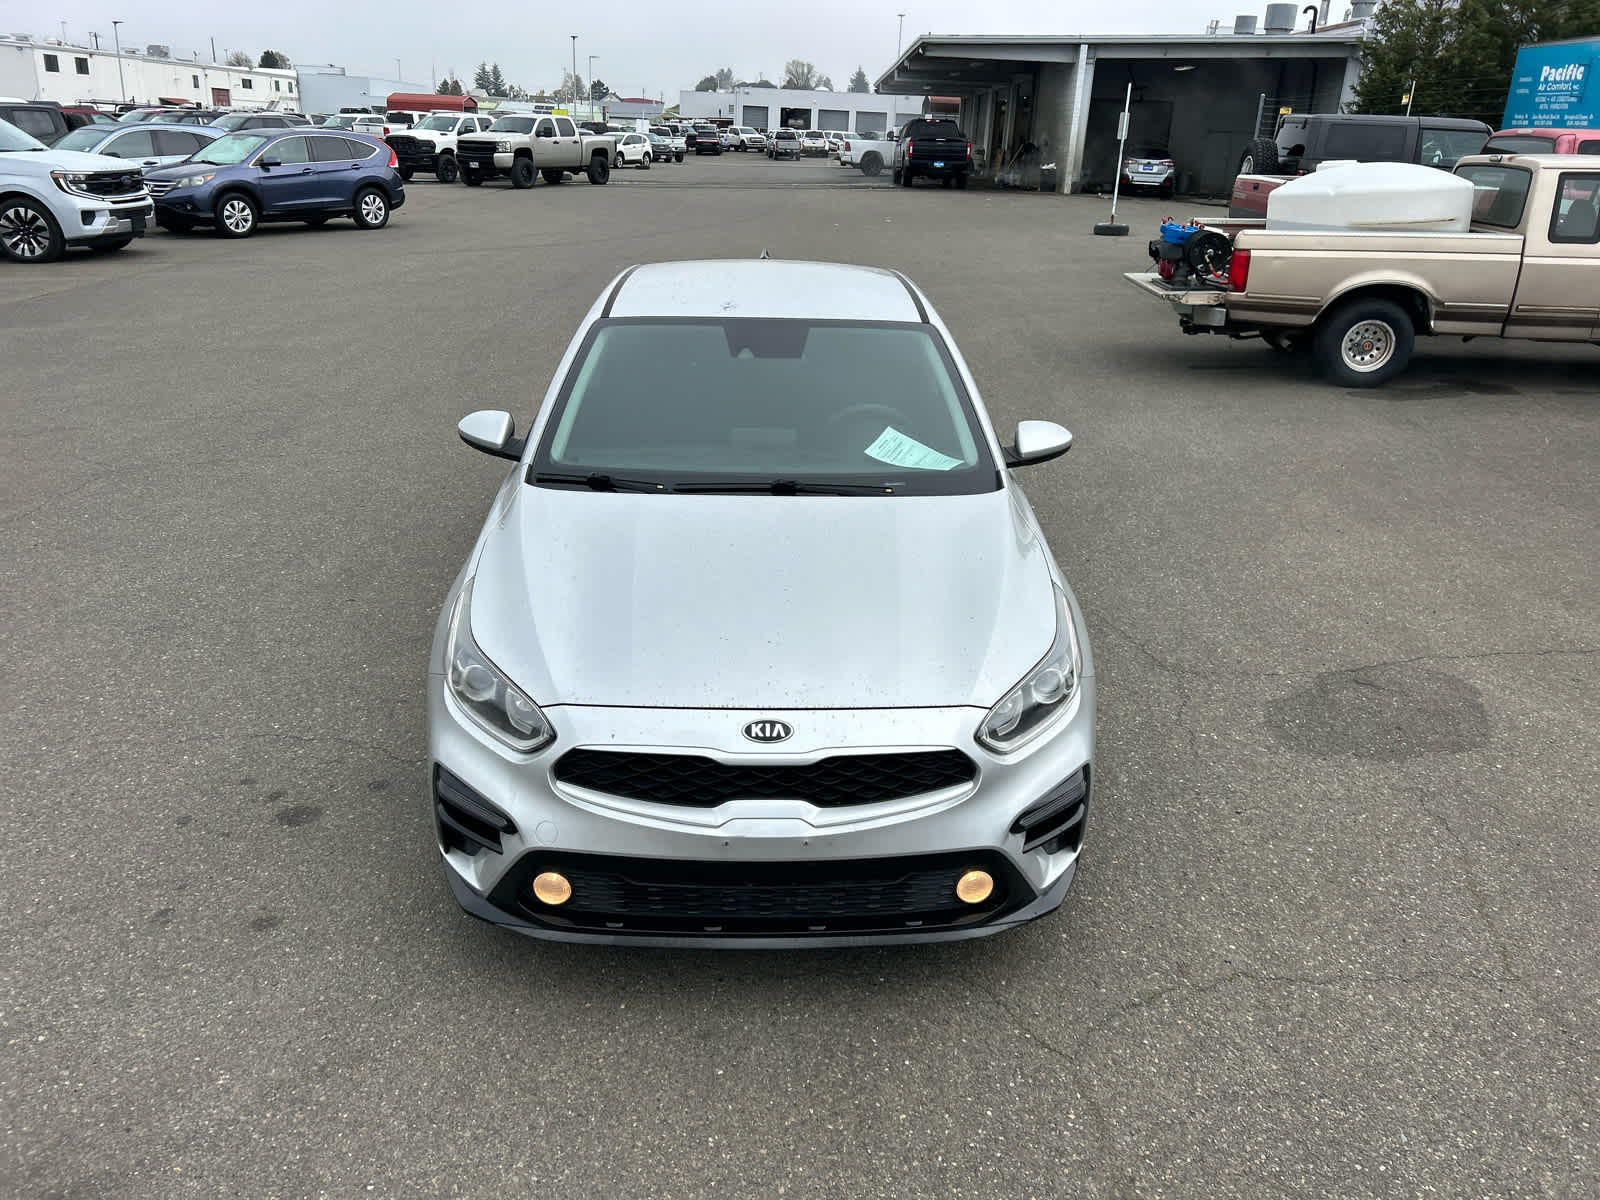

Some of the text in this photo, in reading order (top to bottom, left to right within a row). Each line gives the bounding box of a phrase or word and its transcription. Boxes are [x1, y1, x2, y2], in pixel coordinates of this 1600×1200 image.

[1540, 64, 1584, 82] Pacific
[1538, 83, 1546, 91] Air
[1546, 82, 1572, 91] Comfort
[751, 723, 785, 737] KIA
